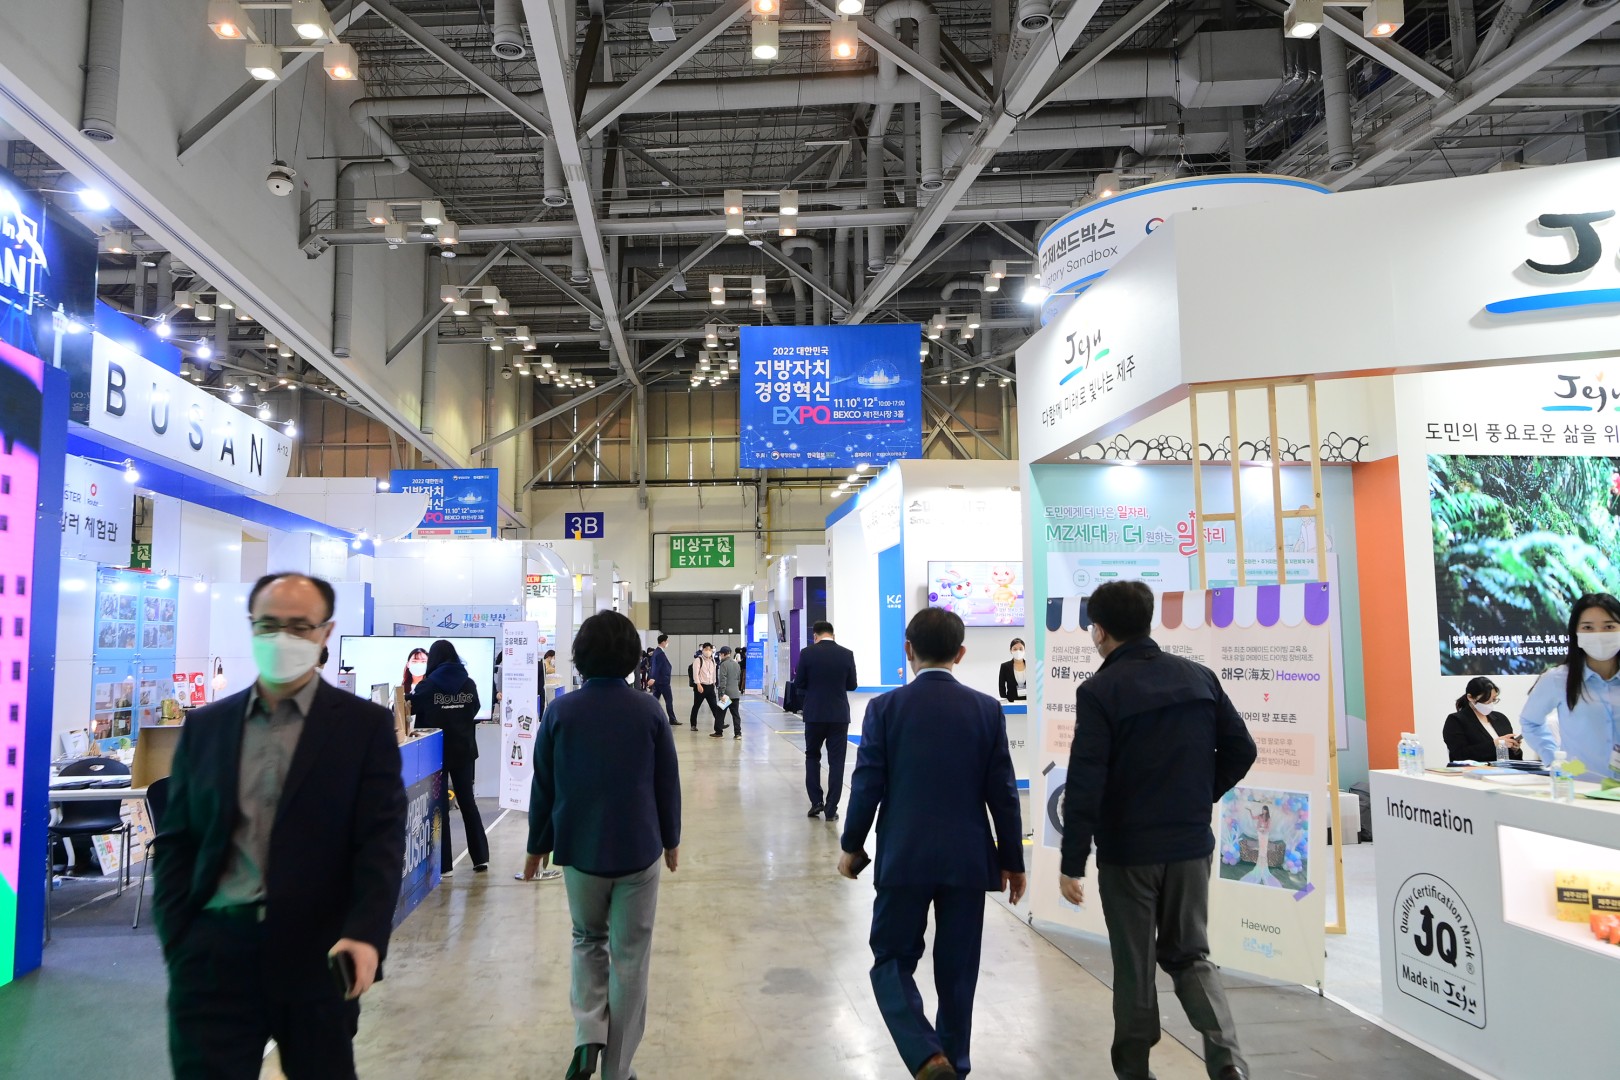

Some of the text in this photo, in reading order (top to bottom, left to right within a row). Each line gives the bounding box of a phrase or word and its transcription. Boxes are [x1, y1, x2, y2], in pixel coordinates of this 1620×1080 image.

[1525, 209, 1620, 276] J
[1066, 245, 1118, 273] Sandbox
[773, 346, 829, 356] 2022 대한민국
[754, 359, 830, 381] 지방자치
[1116, 354, 1136, 382] 제주
[754, 381, 830, 403] 경영혁신
[105, 360, 264, 477] BUSAN
[772, 405, 831, 425] EXPO
[833, 411, 861, 419] BEXCO
[862, 411, 892, 419] 제1전시장
[1426, 422, 1478, 442] 도민의
[1485, 422, 1556, 444] 풍요로운
[1563, 423, 1597, 445] 삶을
[1045, 505, 1149, 519] 도민에게 더 나은 일자리,
[84, 516, 118, 542] 체험관
[570, 516, 599, 534] 3B
[1046, 524, 1119, 543] MZ세대가
[1123, 525, 1143, 544] 더
[1145, 531, 1173, 544] 원하는
[673, 538, 714, 553] 비상구
[679, 555, 711, 566] EXIT
[1051, 666, 1070, 679] 여월
[1221, 668, 1321, 682] 해우(海友) Haewoo
[434, 692, 474, 705] Route
[1046, 703, 1063, 712] 제주를
[1262, 712, 1270, 723] 방
[1272, 713, 1297, 724] 포토존
[1386, 796, 1475, 835] Information
[1241, 918, 1281, 935] Haewoo
[1400, 885, 1475, 959] Quality Certification Mark
[1413, 904, 1458, 968] JQ
[1402, 964, 1477, 1012] Made in Jeju
